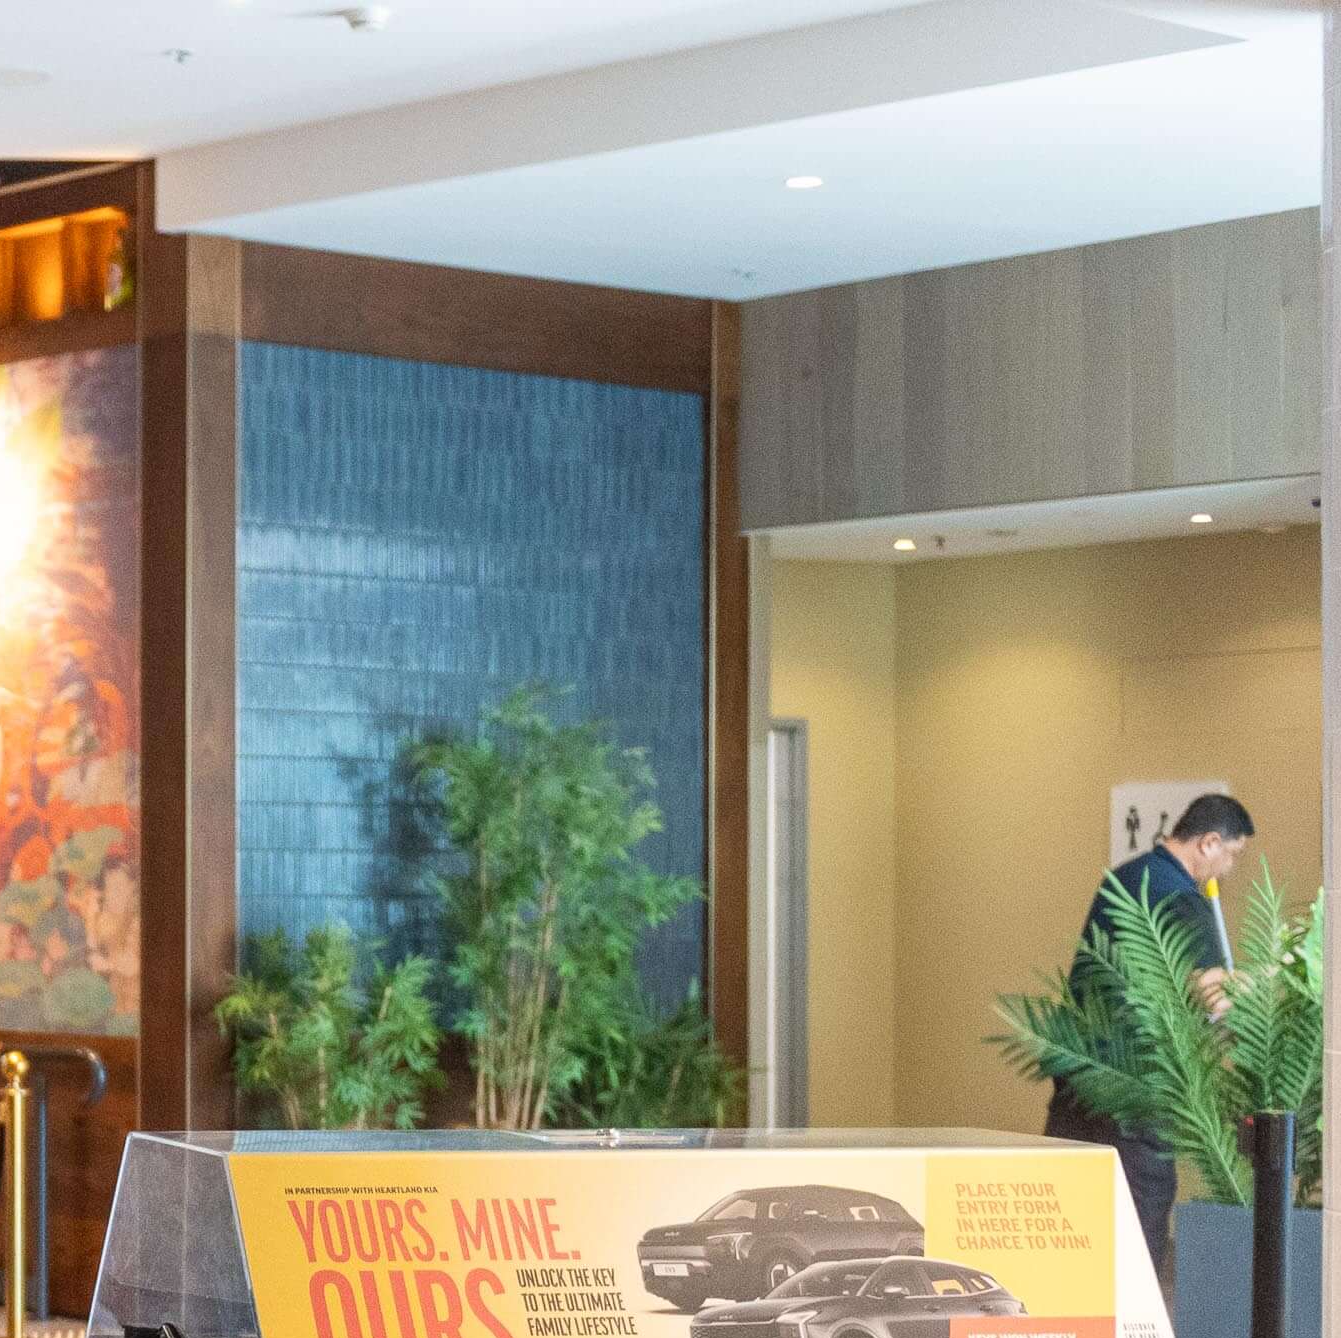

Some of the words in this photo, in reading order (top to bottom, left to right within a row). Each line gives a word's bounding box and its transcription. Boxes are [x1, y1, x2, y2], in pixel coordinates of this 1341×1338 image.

[295, 1187, 350, 1195] PARTNERSHIP
[375, 1186, 422, 1194] HEARTLAND
[955, 1183, 1008, 1197] PLACE
[1010, 1183, 1056, 1197] YOUR
[956, 1200, 1008, 1215] ENTRY
[1013, 1200, 1061, 1214] FORM
[287, 1198, 449, 1263] YOURS.
[450, 1198, 581, 1261] MINE.
[956, 1218, 975, 1232] IN
[978, 1218, 1022, 1232] HERE
[1024, 1218, 1057, 1232] FOR
[1062, 1218, 1074, 1231] A
[956, 1236, 1023, 1250] CHANCE
[1024, 1236, 1047, 1249] TO
[1050, 1235, 1092, 1249] WIN!
[517, 1269, 567, 1288] UNLOCK
[567, 1268, 592, 1287] THE
[593, 1268, 616, 1287] KEY
[522, 1293, 541, 1313] TO
[542, 1293, 564, 1312] THE
[566, 1292, 625, 1312] ULTIMATE
[528, 1317, 574, 1336] FAMILY
[575, 1316, 637, 1335] LIFESTYLE
